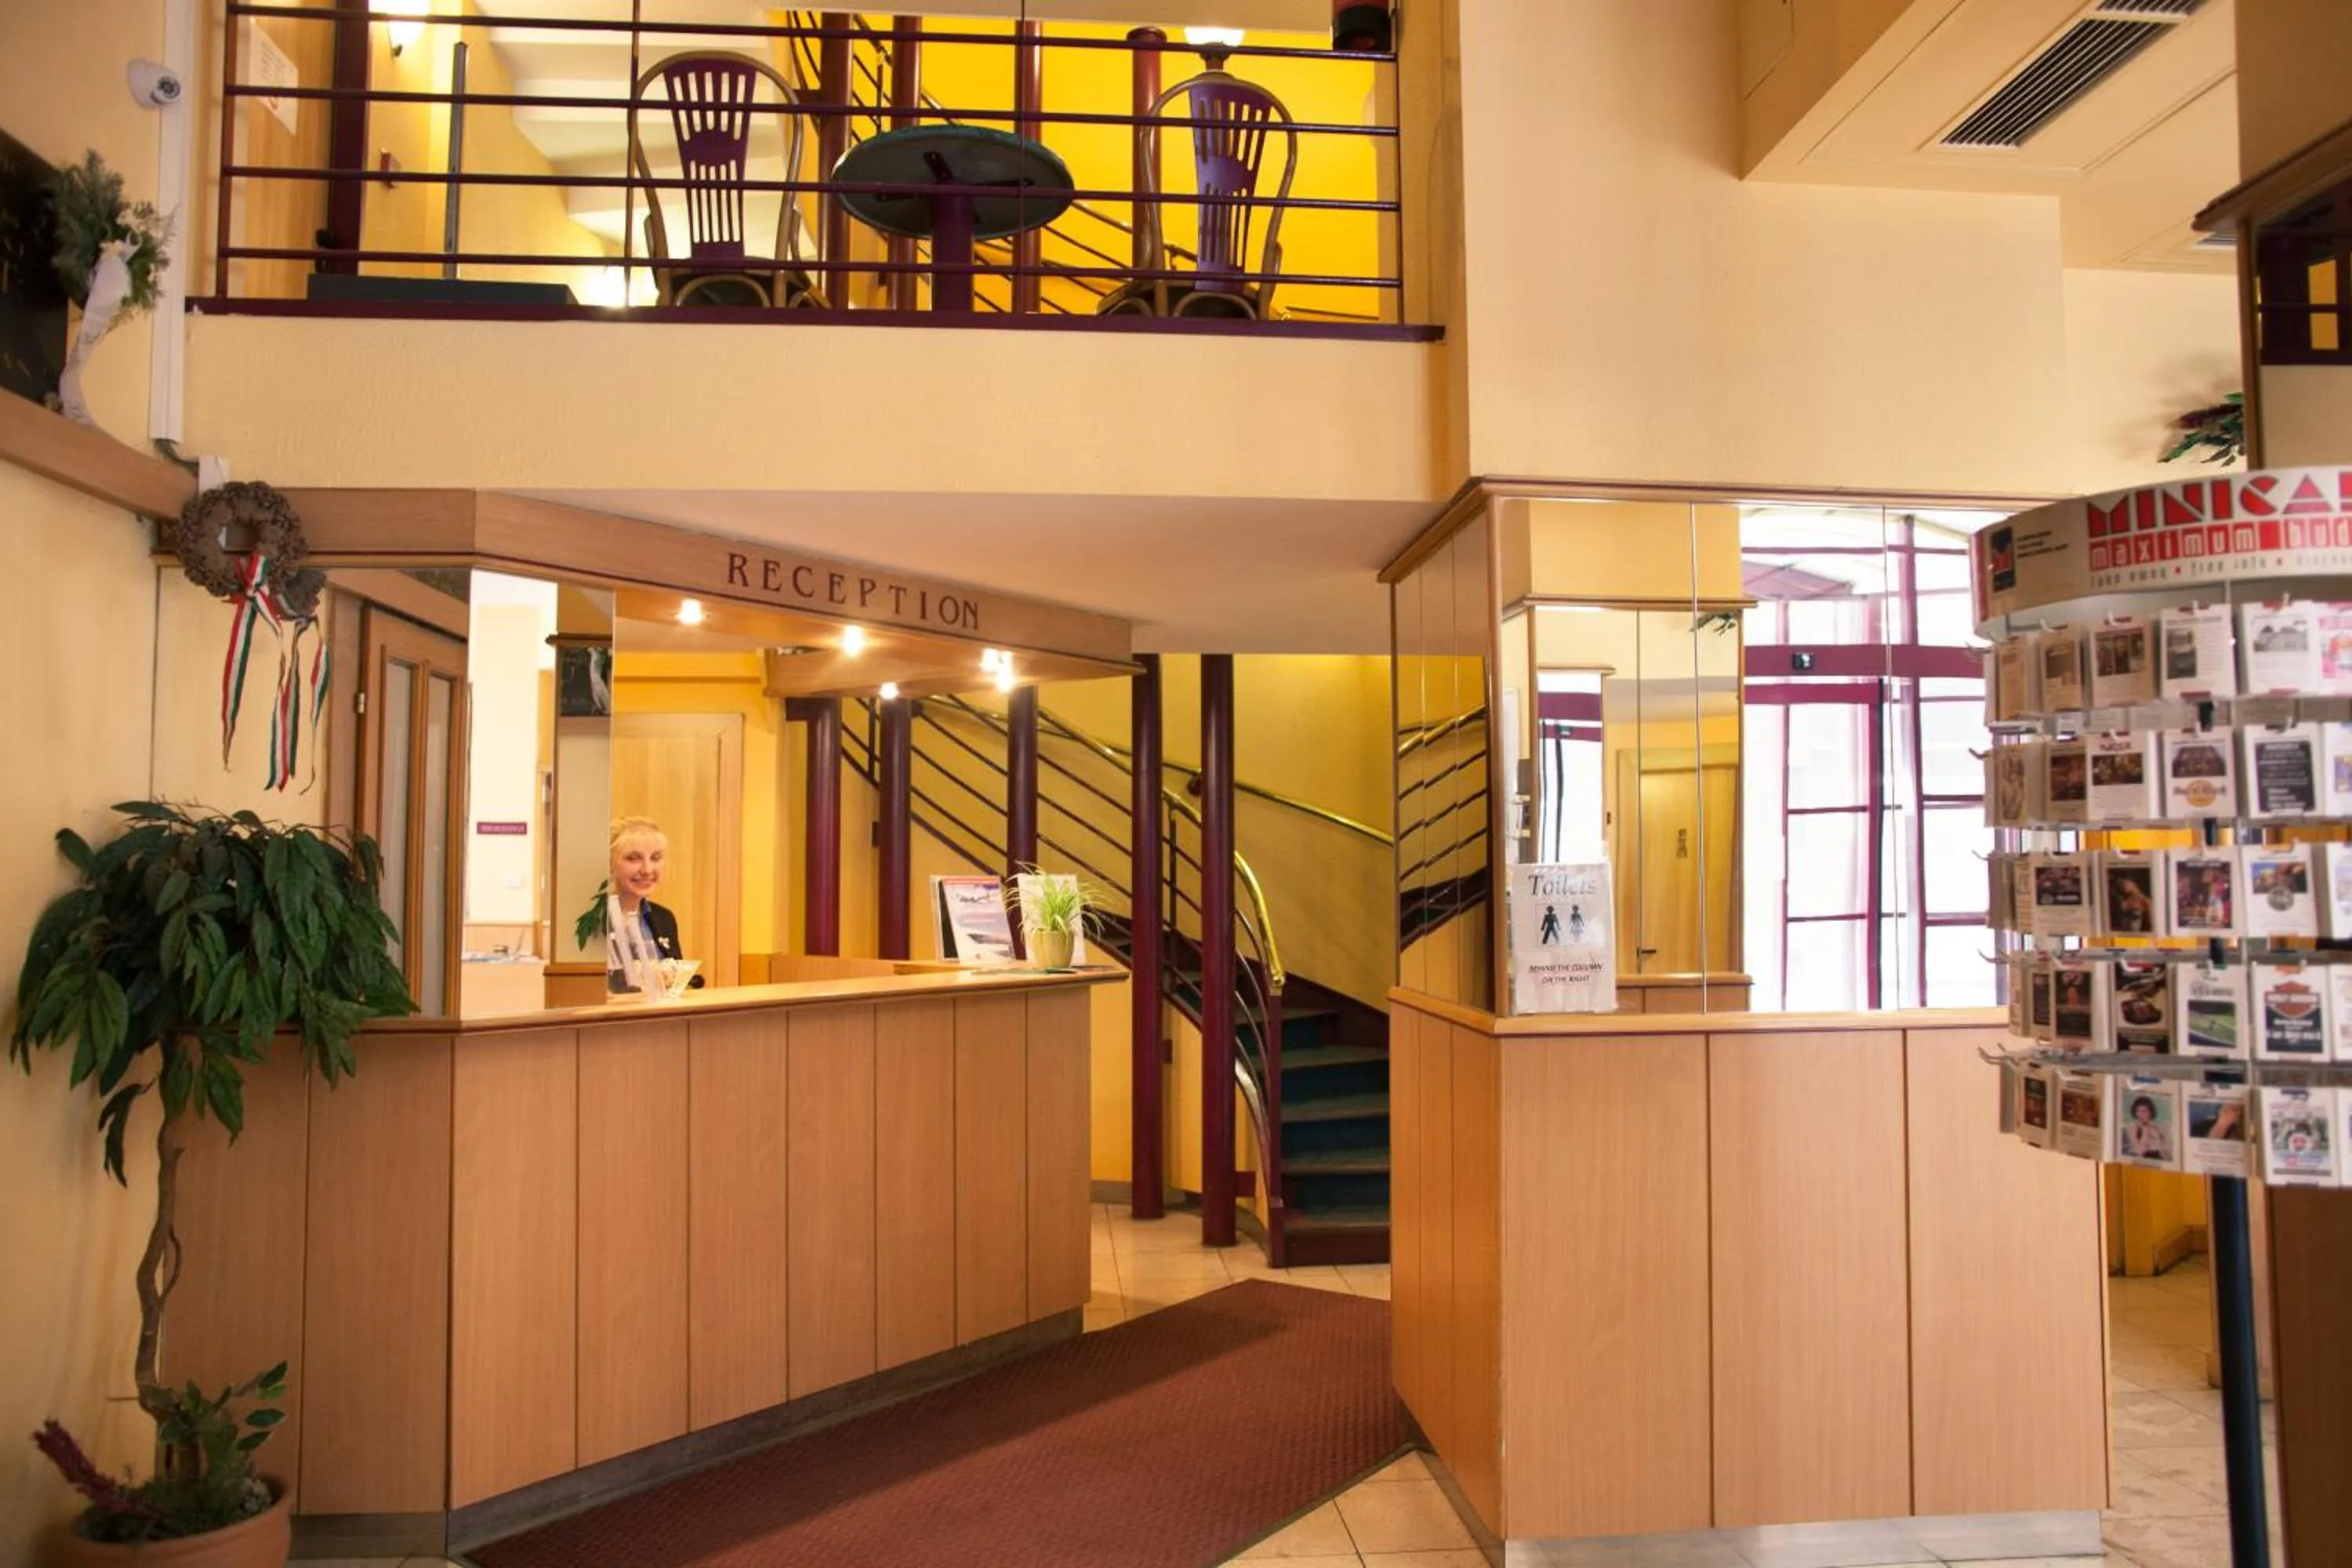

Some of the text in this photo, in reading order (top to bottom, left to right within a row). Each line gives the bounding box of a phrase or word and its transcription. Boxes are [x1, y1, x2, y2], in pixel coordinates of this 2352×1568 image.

[2089, 524, 2256, 572] maximum
[728, 553, 979, 630] RECEPTION
[1529, 874, 1597, 896] Toilets
